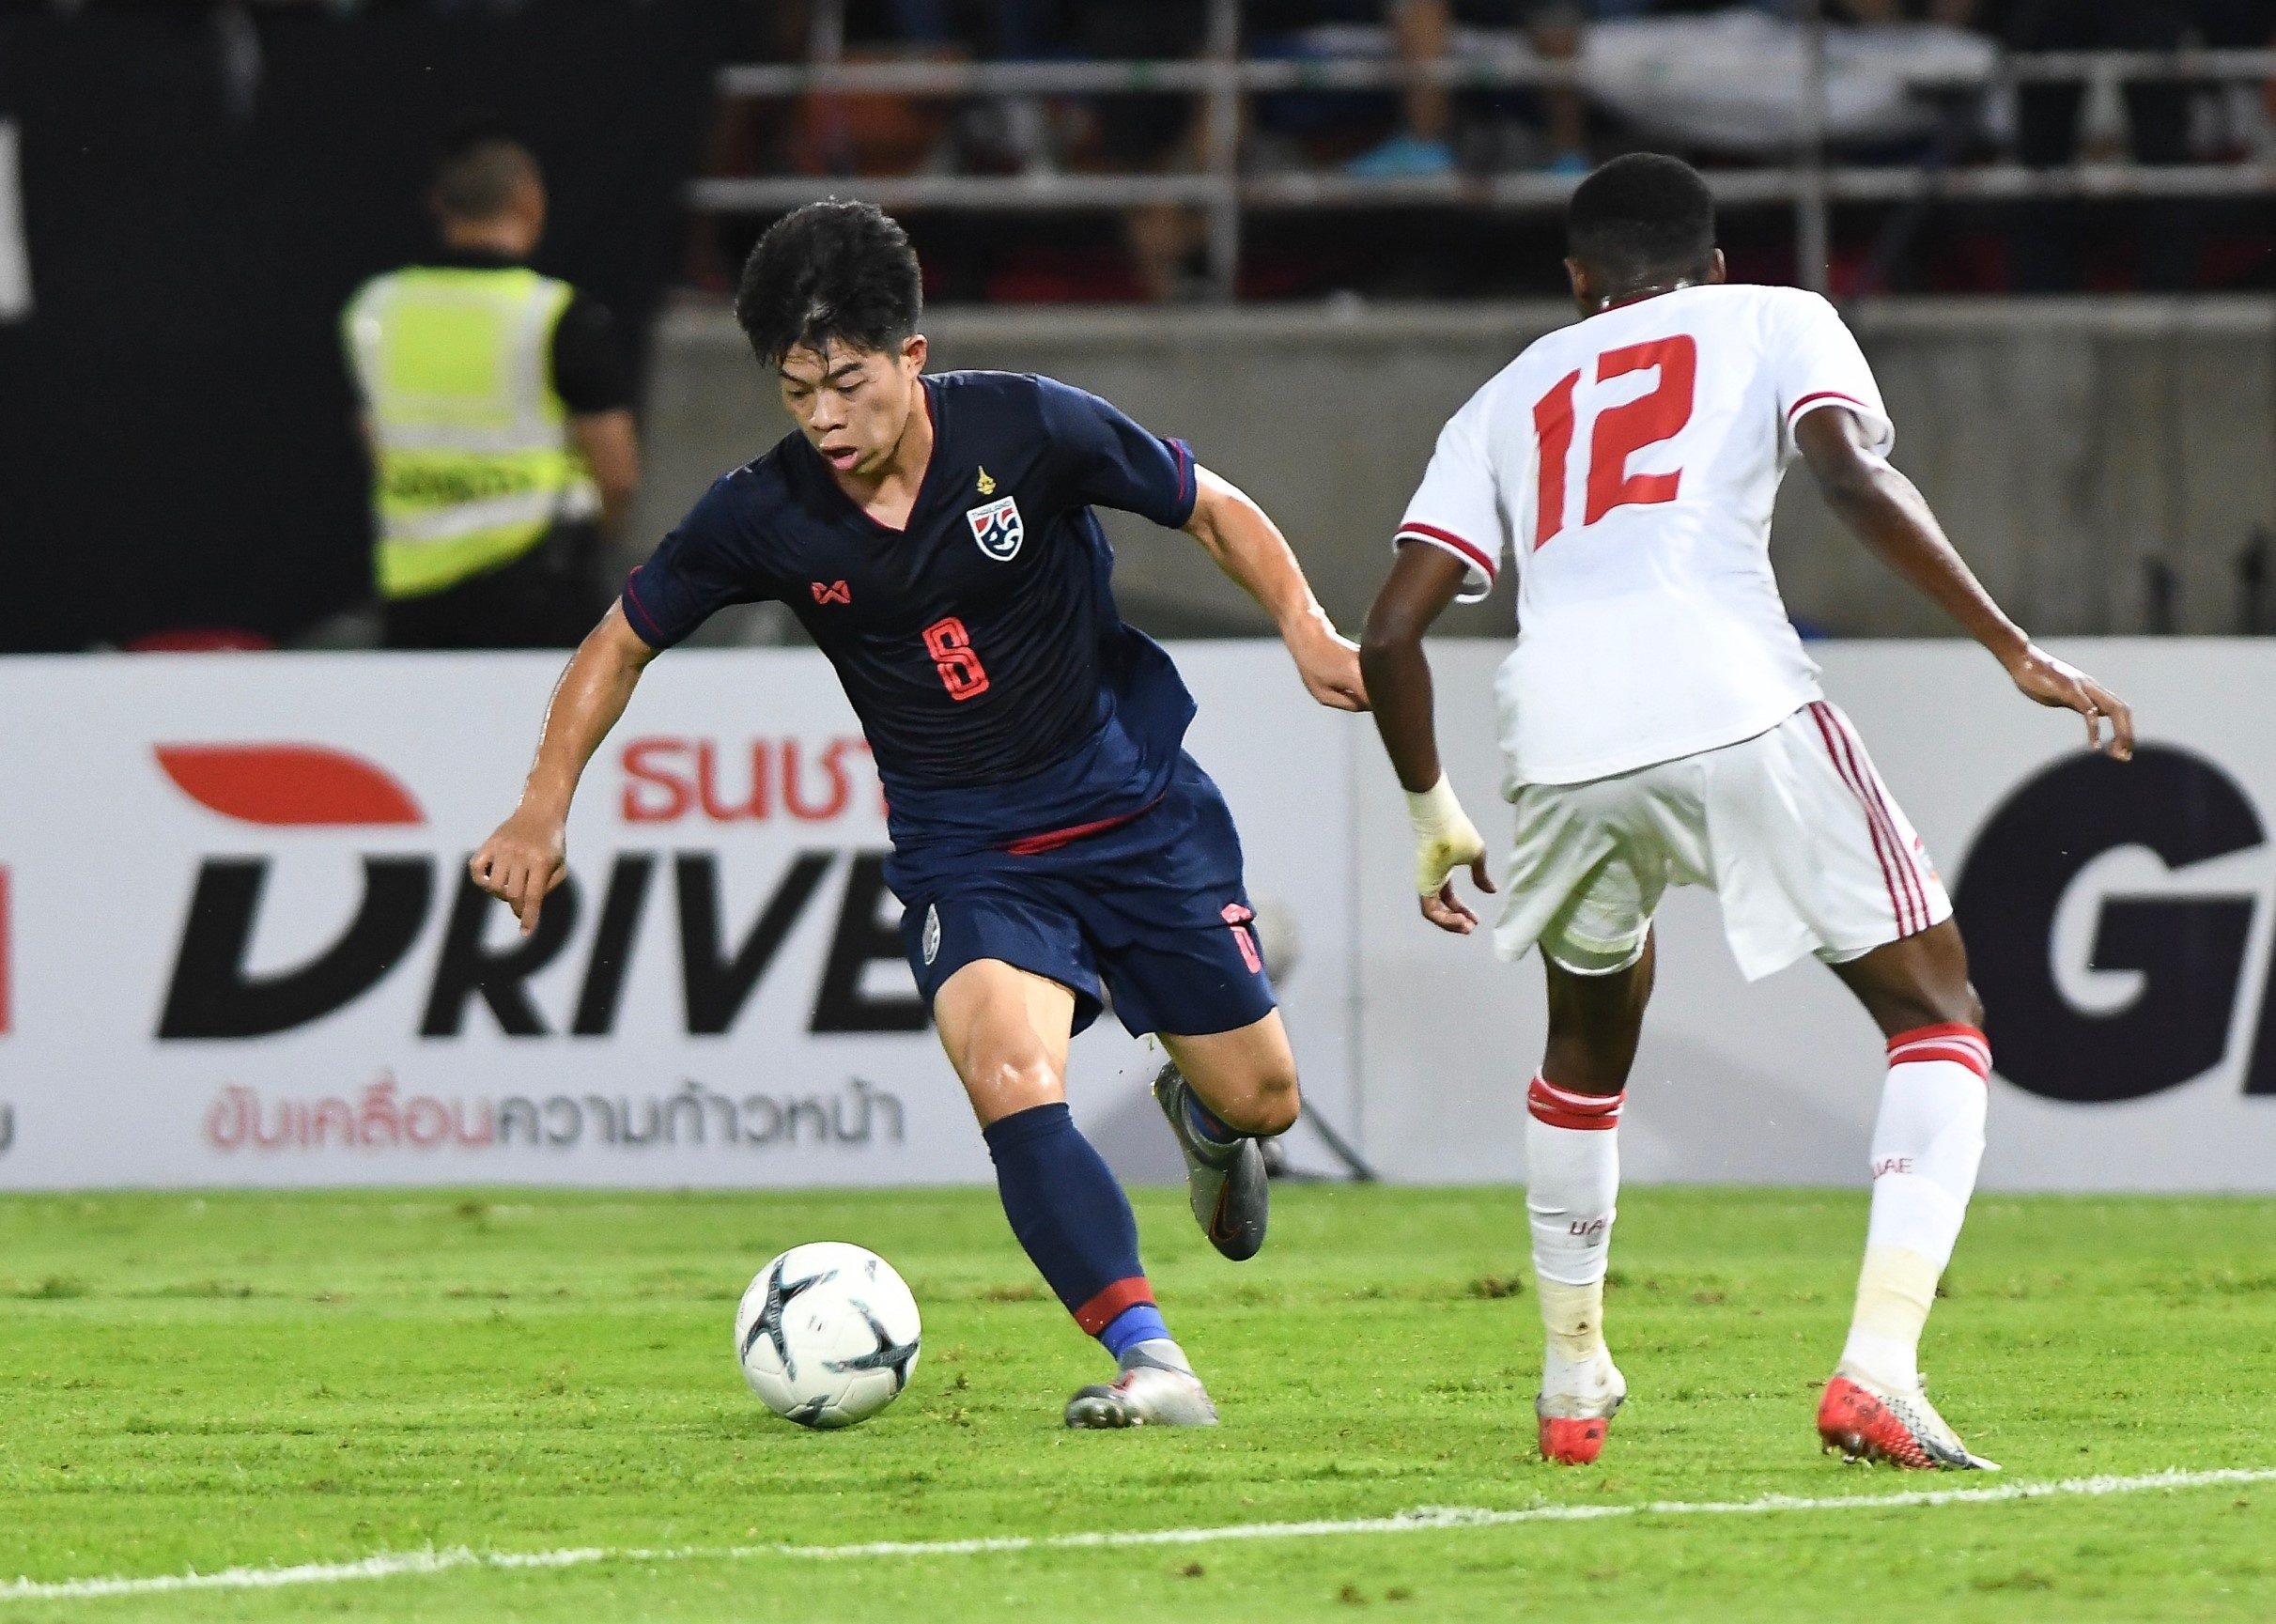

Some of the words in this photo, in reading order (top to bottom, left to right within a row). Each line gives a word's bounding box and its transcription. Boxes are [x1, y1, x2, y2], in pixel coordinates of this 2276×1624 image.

[1533, 333, 1696, 552] 12
[921, 616, 990, 701] 8
[152, 740, 937, 1040] DRIVE
[1951, 736, 2276, 1105] G
